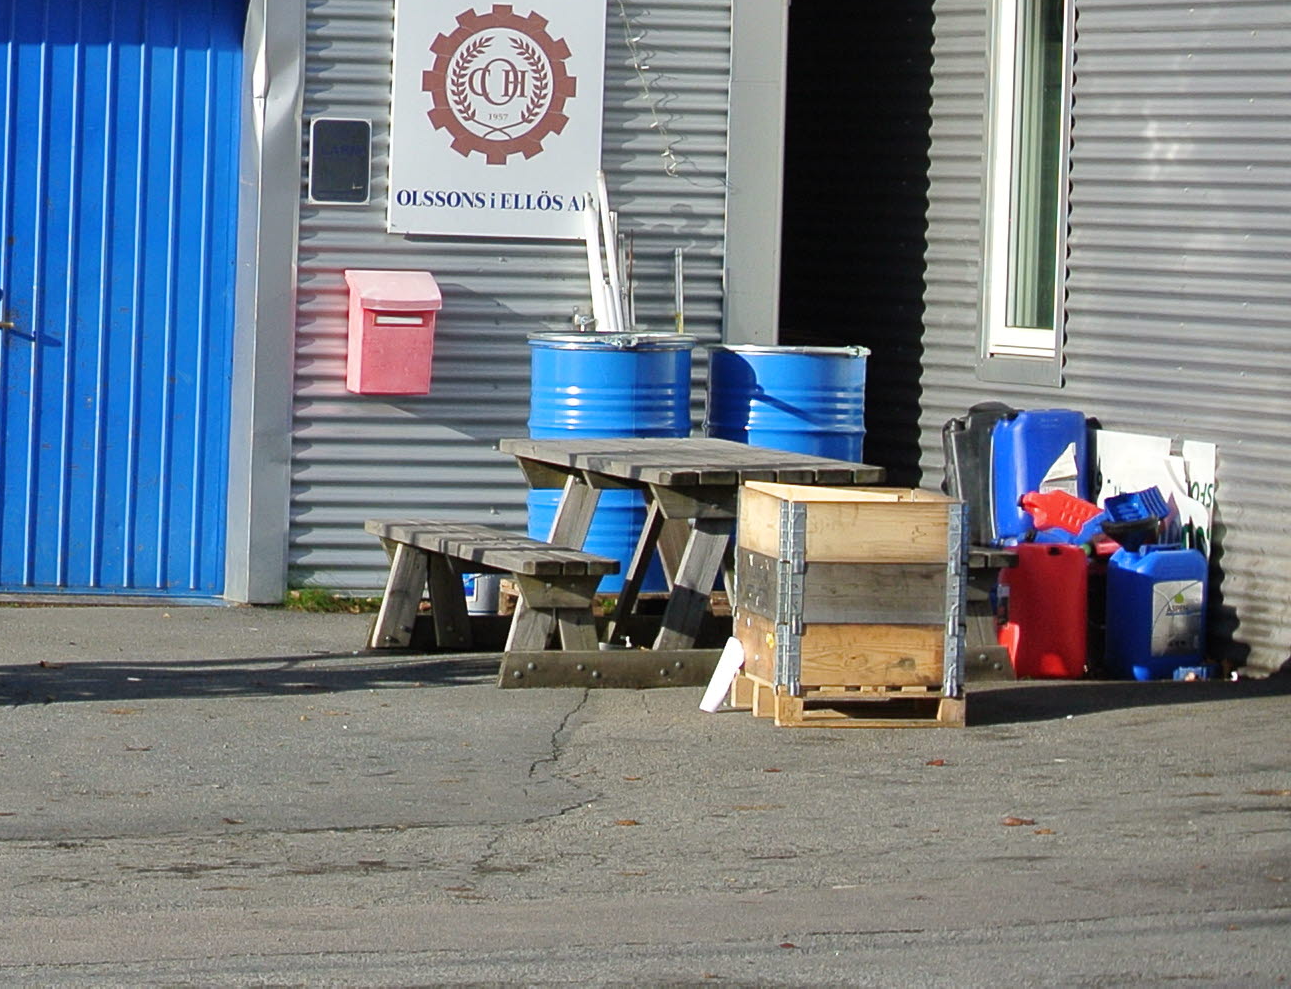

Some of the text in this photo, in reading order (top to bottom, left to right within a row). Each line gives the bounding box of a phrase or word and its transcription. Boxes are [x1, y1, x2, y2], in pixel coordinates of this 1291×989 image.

[487, 112, 509, 121] 1957
[395, 189, 486, 209] OLSSONS
[500, 188, 564, 211] ELLÖS
